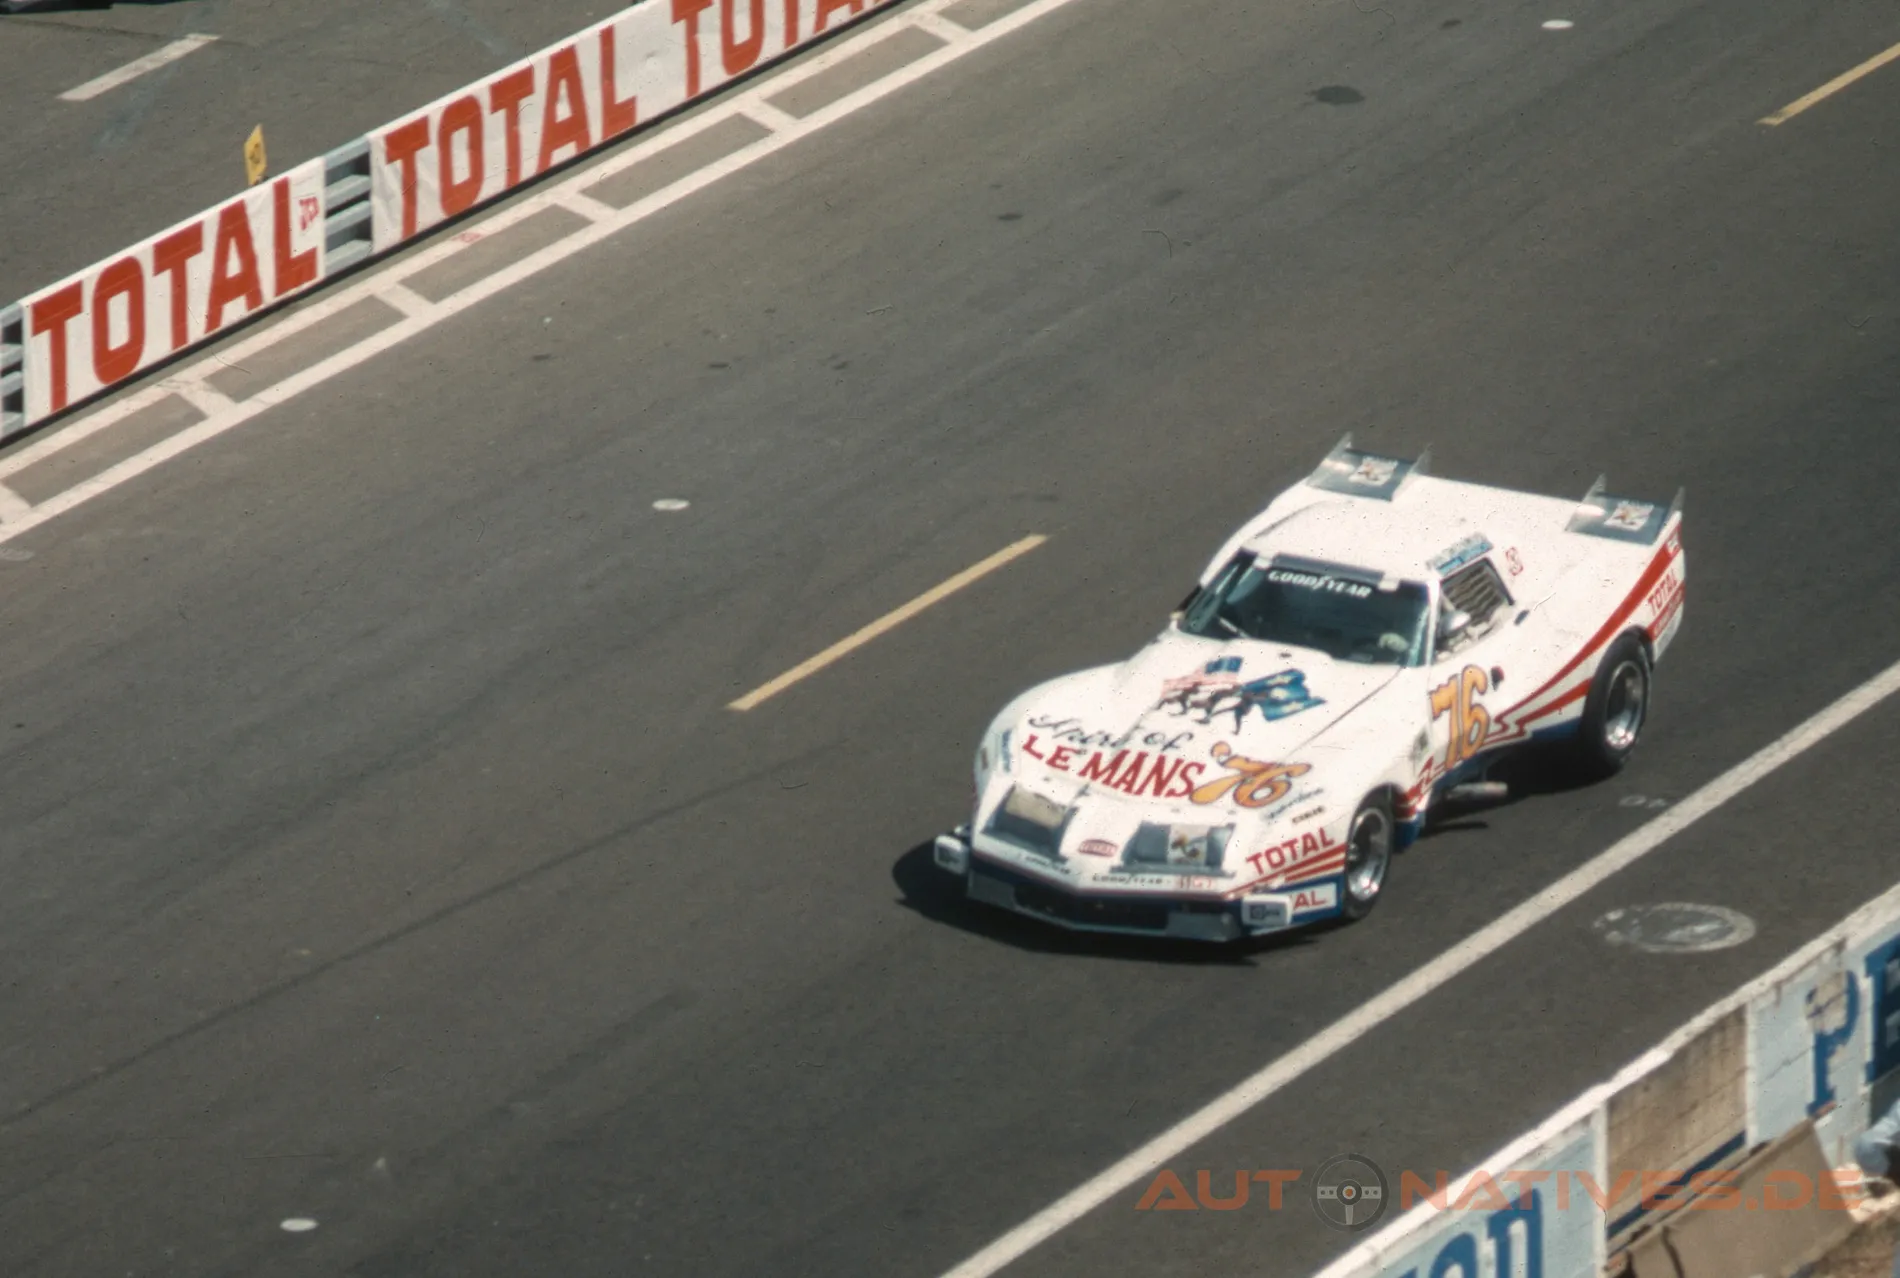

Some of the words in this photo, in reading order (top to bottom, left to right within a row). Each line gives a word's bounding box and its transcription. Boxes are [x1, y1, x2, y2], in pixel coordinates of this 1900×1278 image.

[385, 27, 638, 240] TOTAL
[32, 177, 318, 413] TOTAL
[1268, 569, 1372, 598] GOODYEAR
[1143, 731, 1194, 751] of
[1430, 664, 1489, 770] 76
[1022, 734, 1079, 771] LE
[1077, 749, 1206, 798] MANS
[1245, 827, 1335, 876] TOTAL
